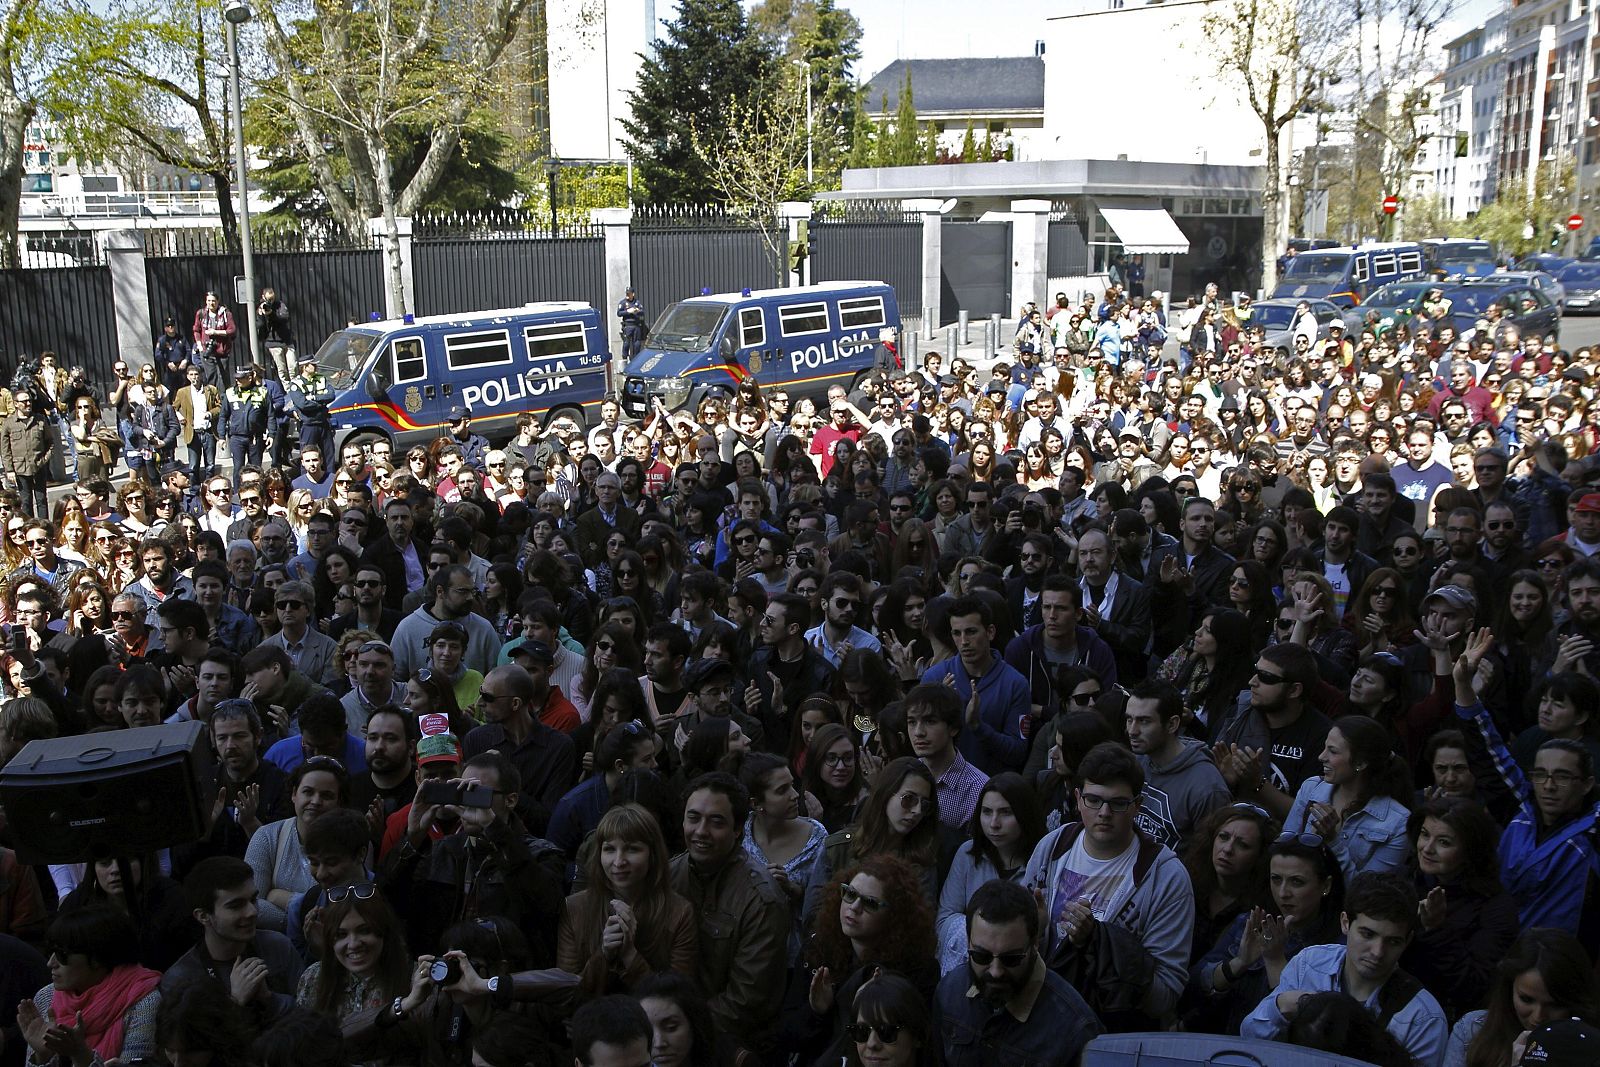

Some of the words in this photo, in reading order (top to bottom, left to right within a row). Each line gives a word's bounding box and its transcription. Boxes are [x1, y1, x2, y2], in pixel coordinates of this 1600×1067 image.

[790, 331, 874, 374] POLICIA
[462, 360, 574, 412] POLICIA
[1271, 744, 1303, 758] NEMY
